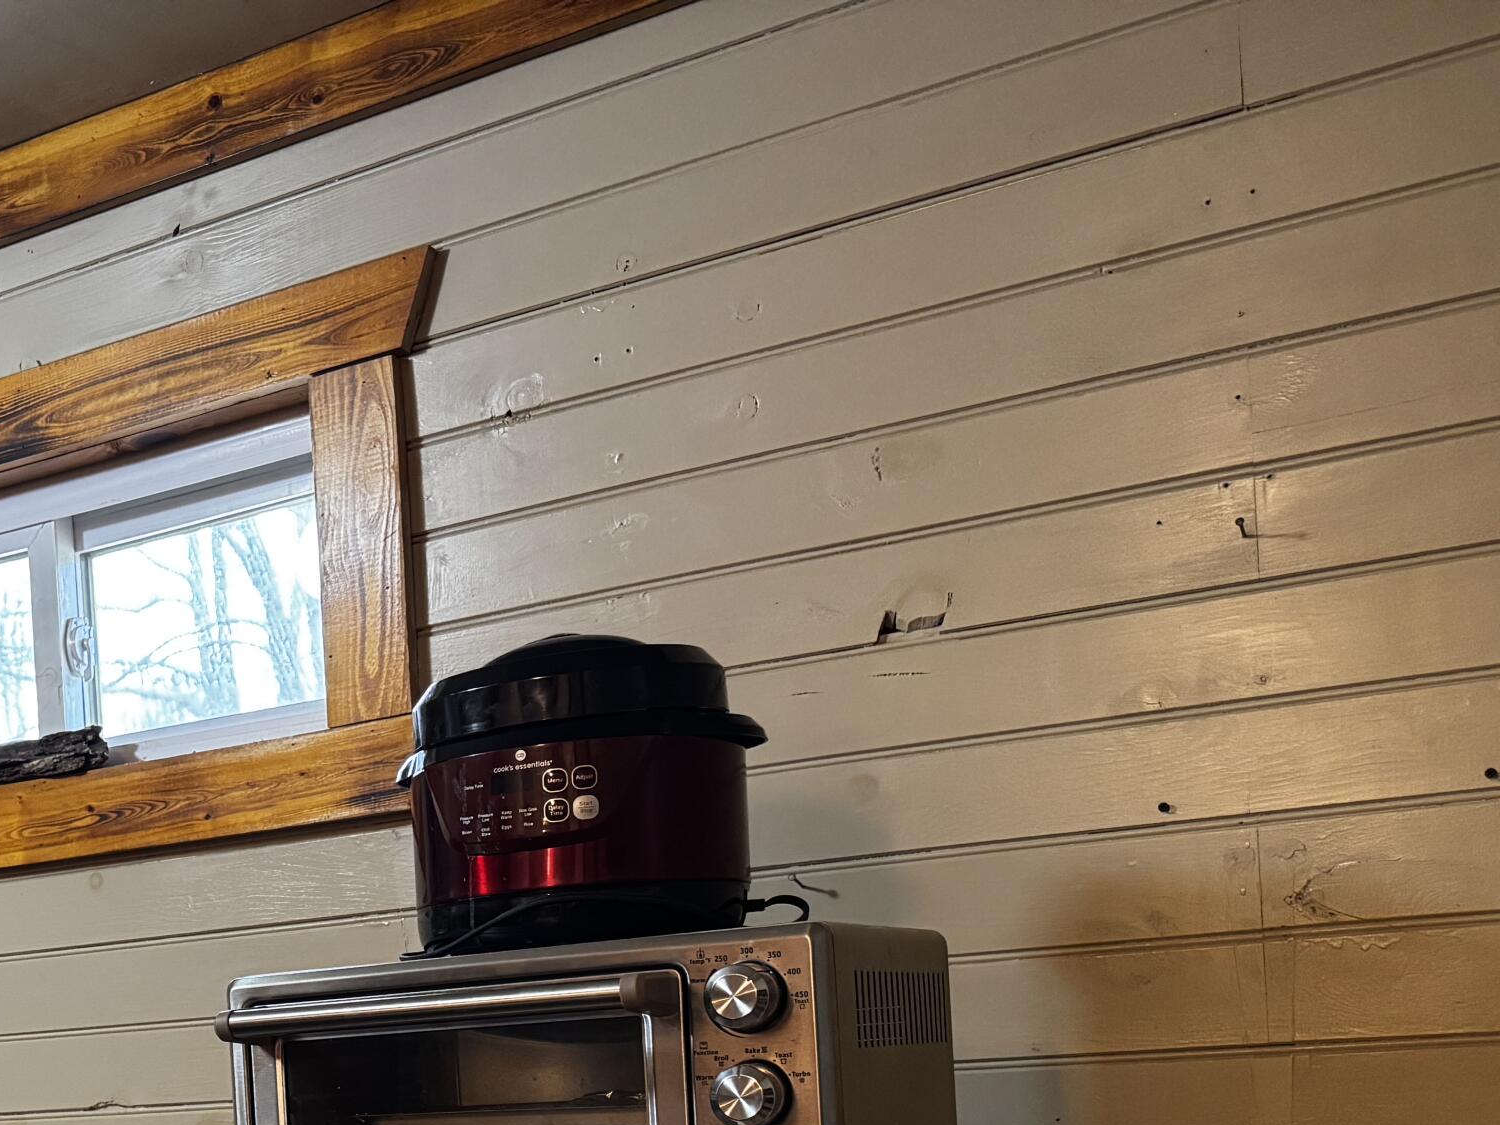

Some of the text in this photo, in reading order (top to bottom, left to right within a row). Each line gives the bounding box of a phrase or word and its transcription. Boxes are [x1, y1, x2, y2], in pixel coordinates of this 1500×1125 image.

[493, 759, 551, 774] cook's essentials
[767, 951, 781, 959] 350
